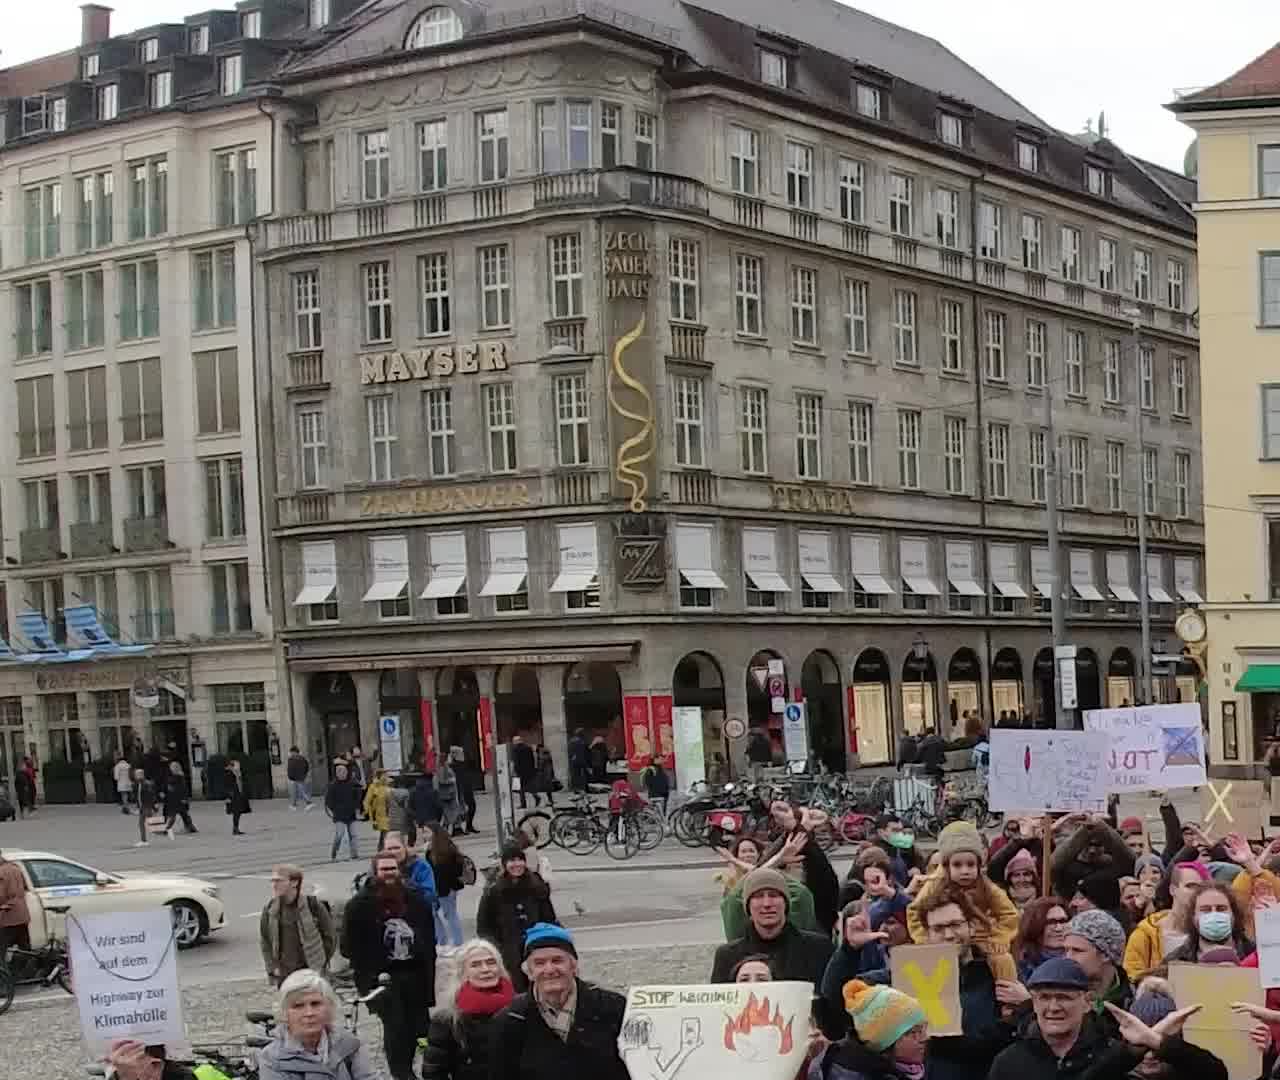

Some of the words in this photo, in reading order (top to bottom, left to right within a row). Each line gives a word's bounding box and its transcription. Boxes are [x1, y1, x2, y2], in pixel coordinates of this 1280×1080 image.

[360, 341, 508, 385] MAYSER
[95, 936, 118, 948] Wir
[119, 931, 146, 946] sind
[122, 956, 148, 969] dem
[632, 989, 674, 1006] STOP
[94, 1007, 168, 1030] Klimahölle
